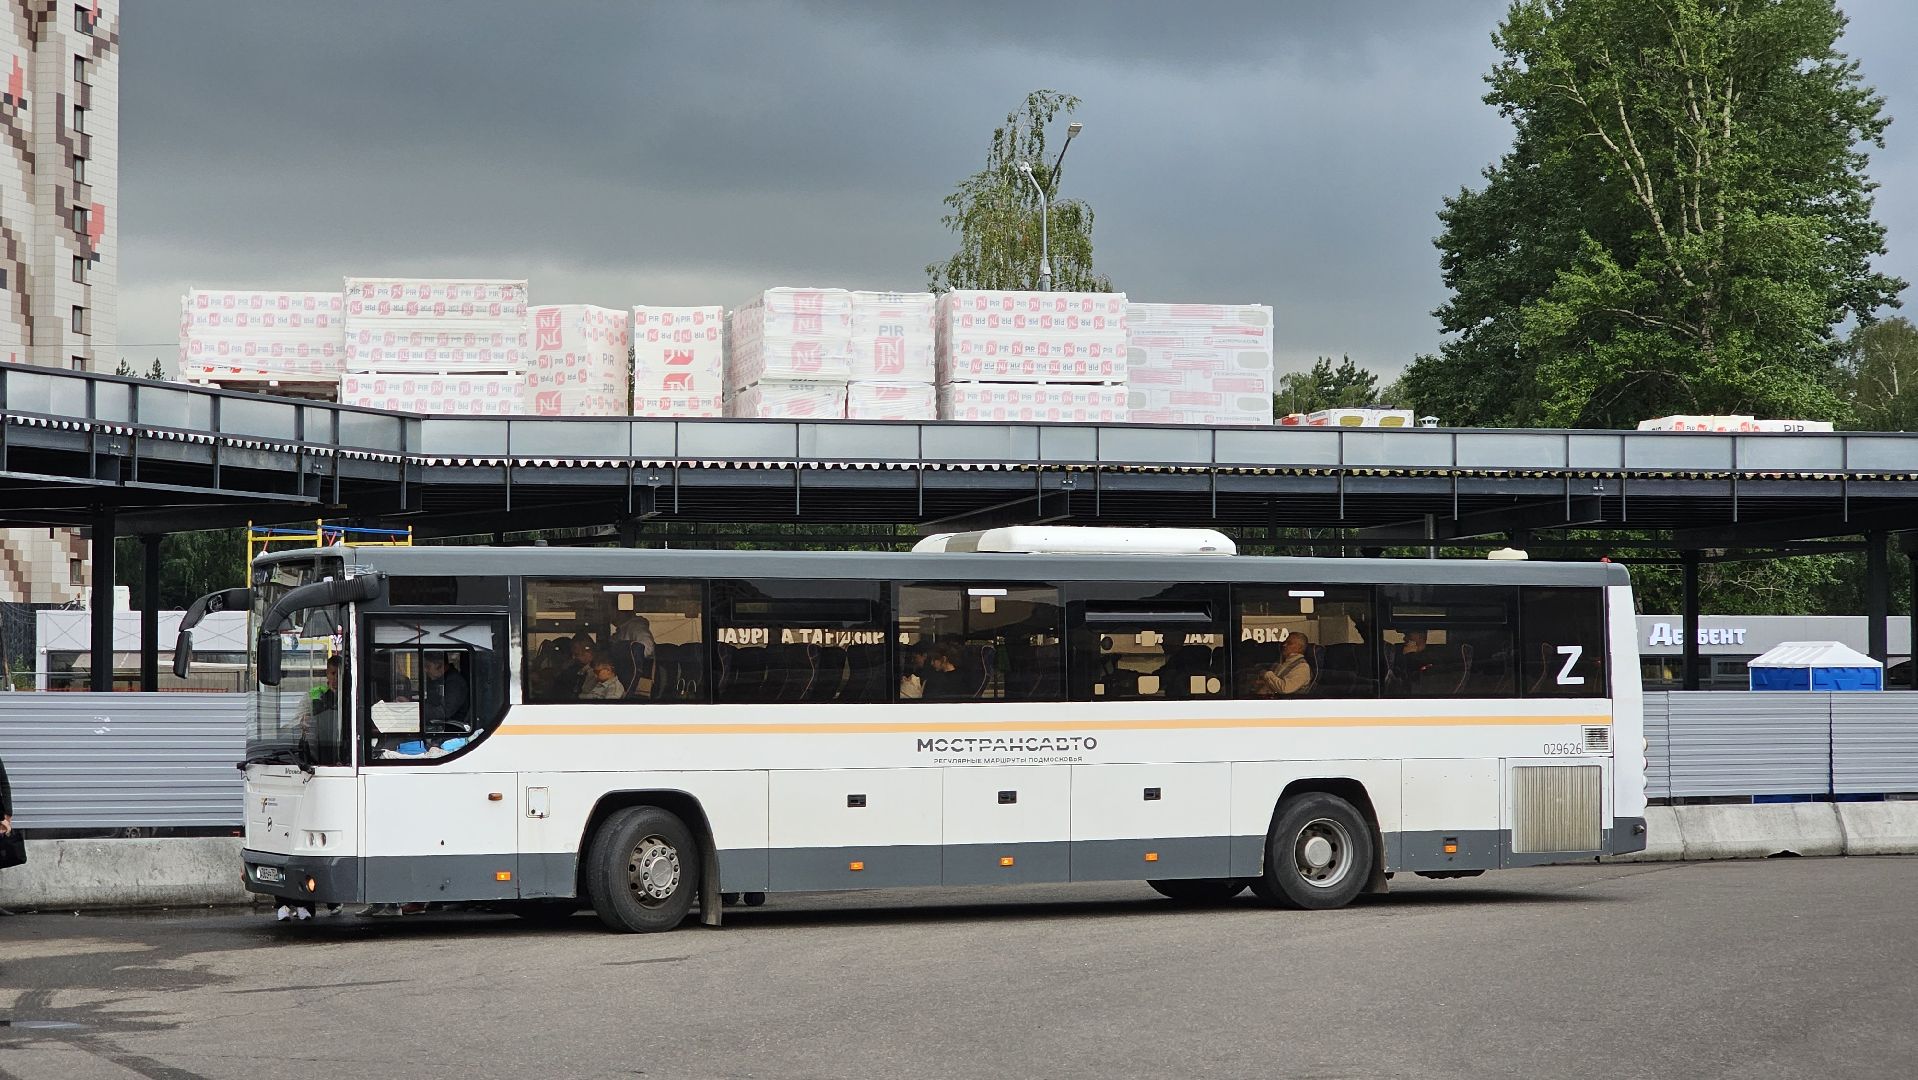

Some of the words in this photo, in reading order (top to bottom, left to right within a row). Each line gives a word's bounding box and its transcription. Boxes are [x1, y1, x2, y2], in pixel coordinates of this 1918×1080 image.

[879, 325, 903, 336] PIR
[1649, 623, 1746, 646] Дебент
[1557, 646, 1585, 685] Z
[917, 737, 1097, 752] МОСТРАНСАВТО
[1543, 743, 1583, 755] 029626
